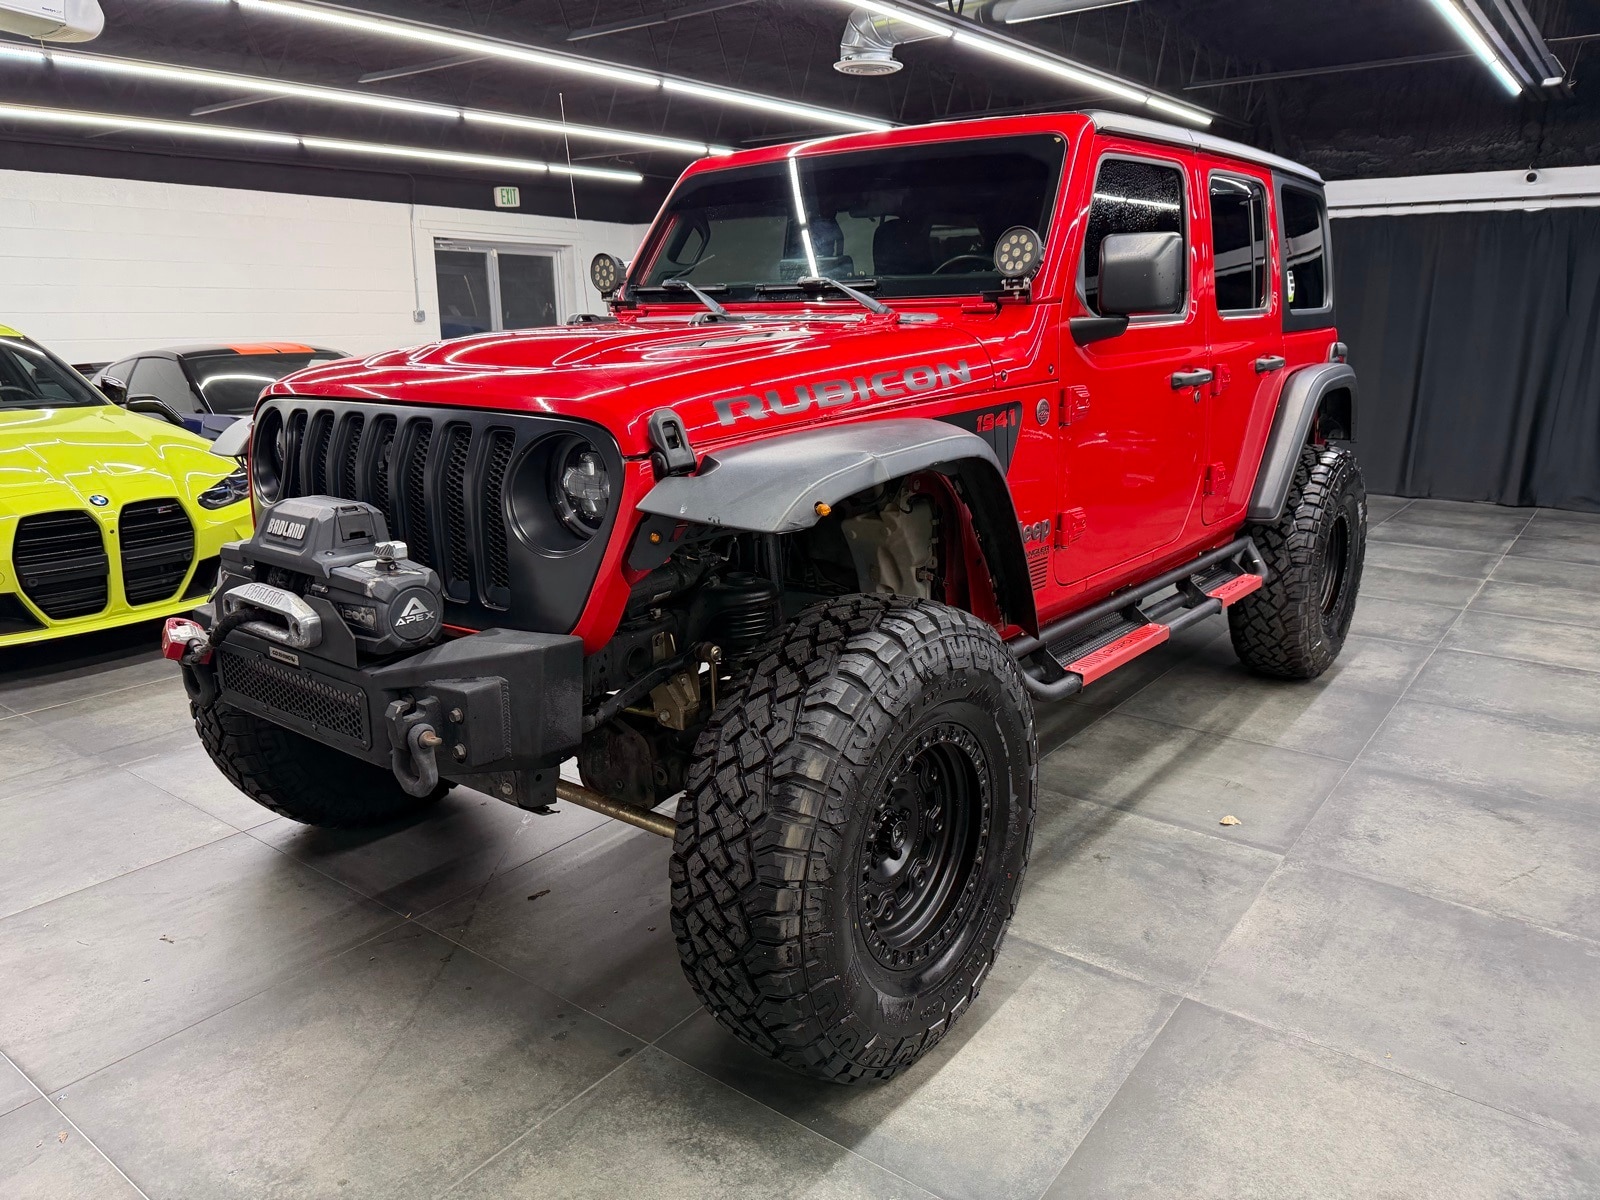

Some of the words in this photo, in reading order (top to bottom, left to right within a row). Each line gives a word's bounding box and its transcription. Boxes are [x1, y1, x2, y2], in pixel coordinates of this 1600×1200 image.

[501, 188, 517, 205] EXIT
[713, 359, 972, 427] RUBICON
[976, 408, 1016, 433] 1941
[266, 518, 306, 540] BADLAND
[395, 611, 435, 627] APEX
